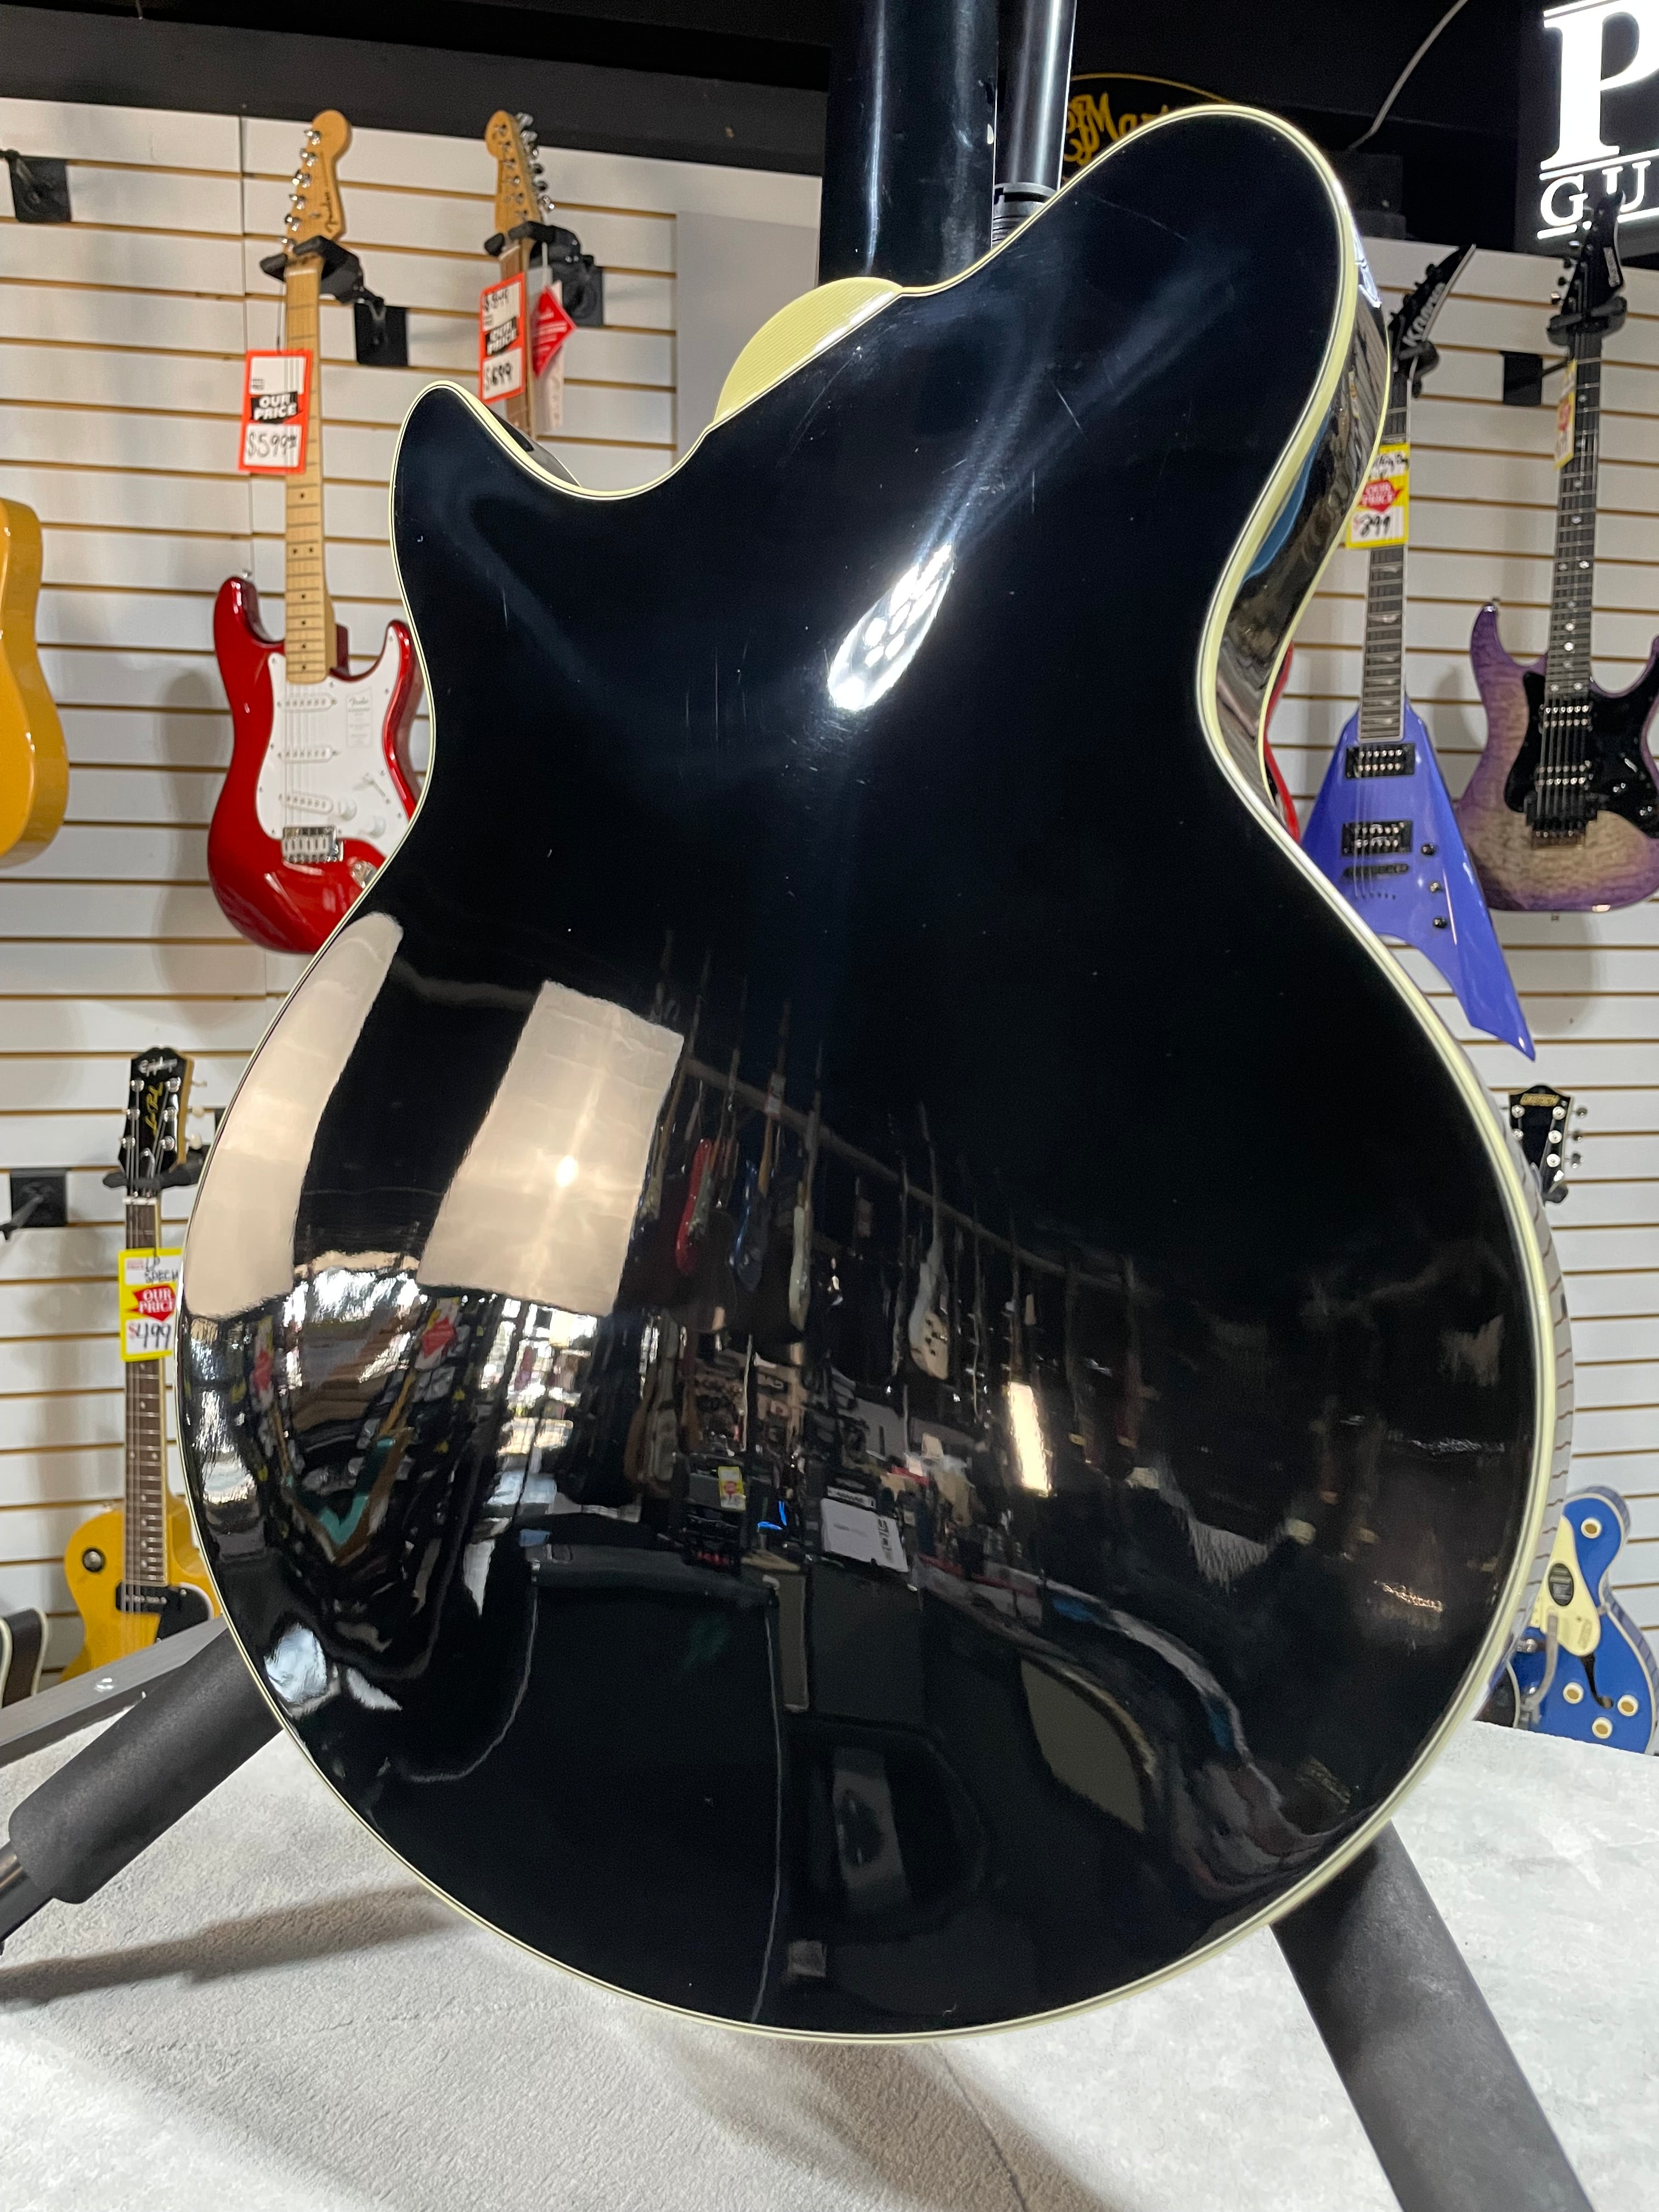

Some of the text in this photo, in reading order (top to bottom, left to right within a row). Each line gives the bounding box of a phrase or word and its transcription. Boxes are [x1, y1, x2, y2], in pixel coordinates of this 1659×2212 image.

[258, 393, 291, 409] OUR
[253, 403, 297, 421] PRICE
[143, 1288, 172, 1301] OUR
